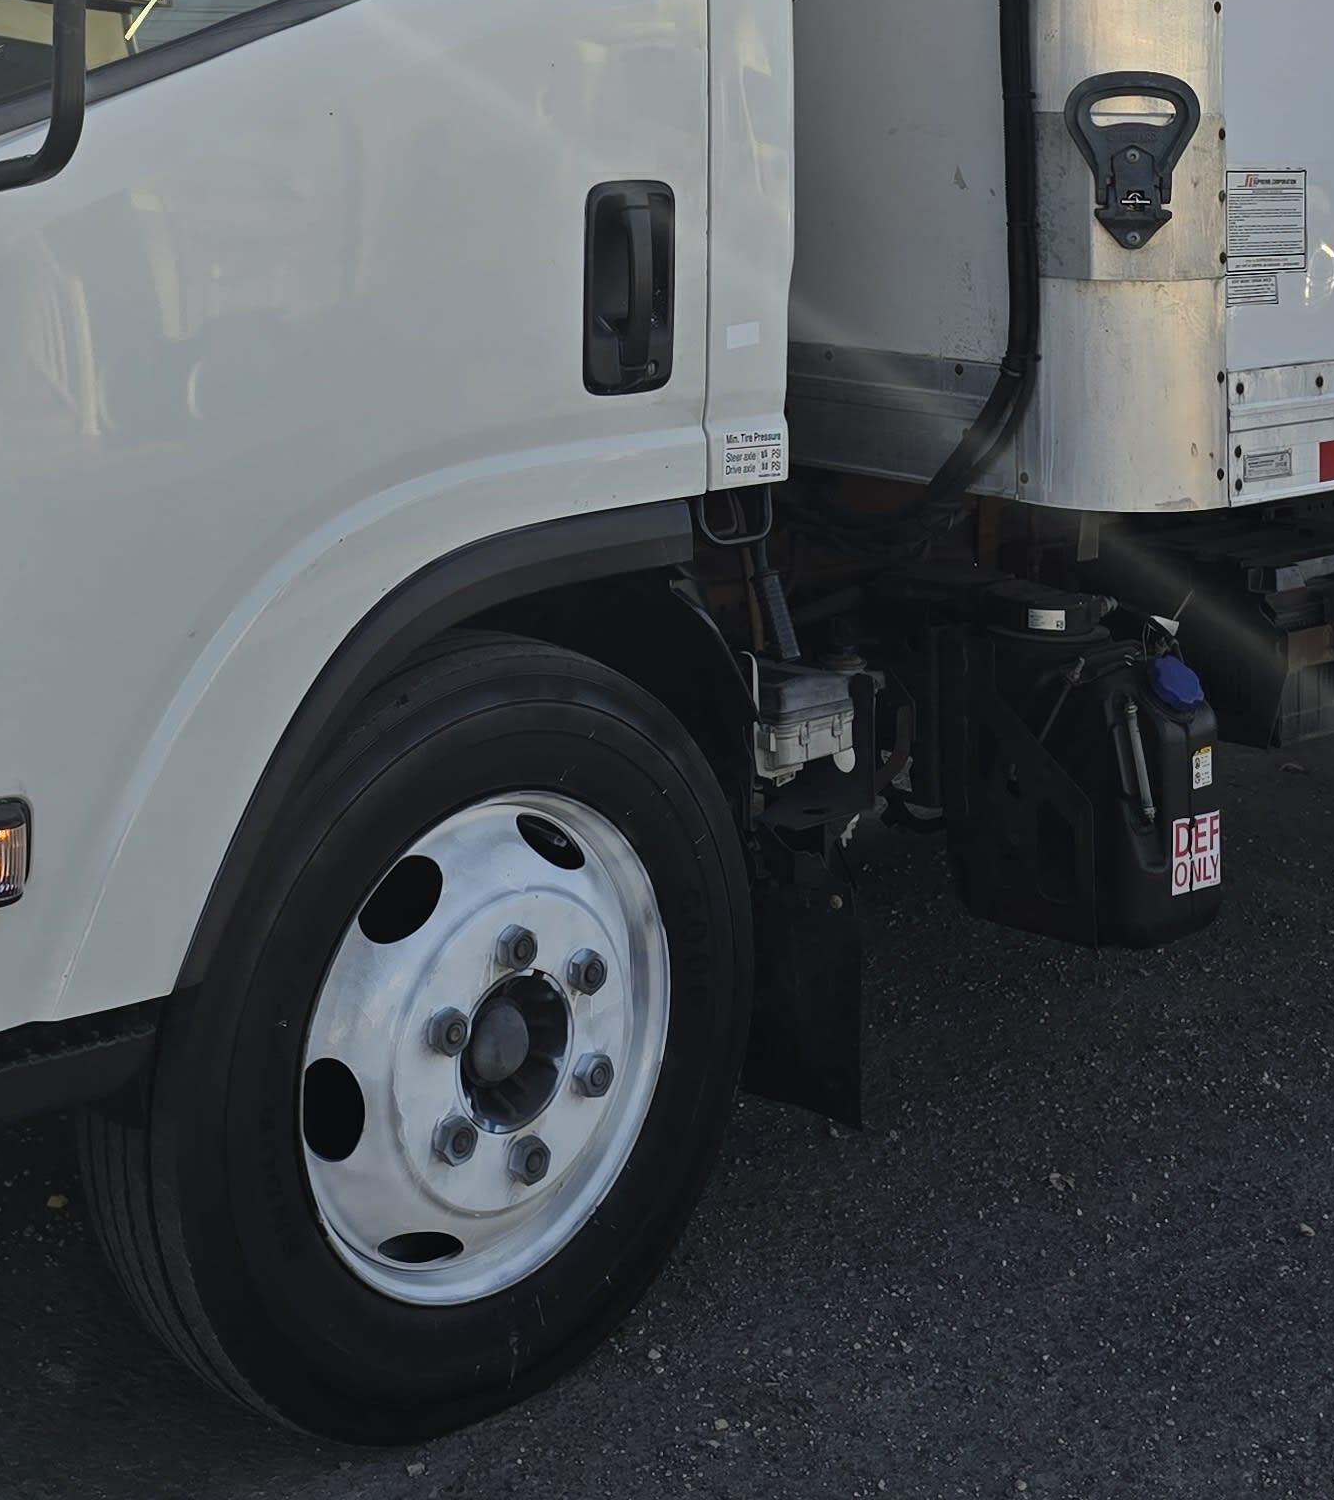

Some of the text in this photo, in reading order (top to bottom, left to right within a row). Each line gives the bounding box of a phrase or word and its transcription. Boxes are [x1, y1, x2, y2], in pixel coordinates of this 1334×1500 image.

[741, 433, 753, 443] Tire
[754, 432, 781, 442] Pressure
[726, 452, 743, 463] Steer
[743, 452, 756, 461] axle
[725, 465, 742, 476] Drive
[743, 464, 756, 474] axle
[1175, 815, 1220, 858] DEF
[1174, 853, 1219, 888] ONLY
